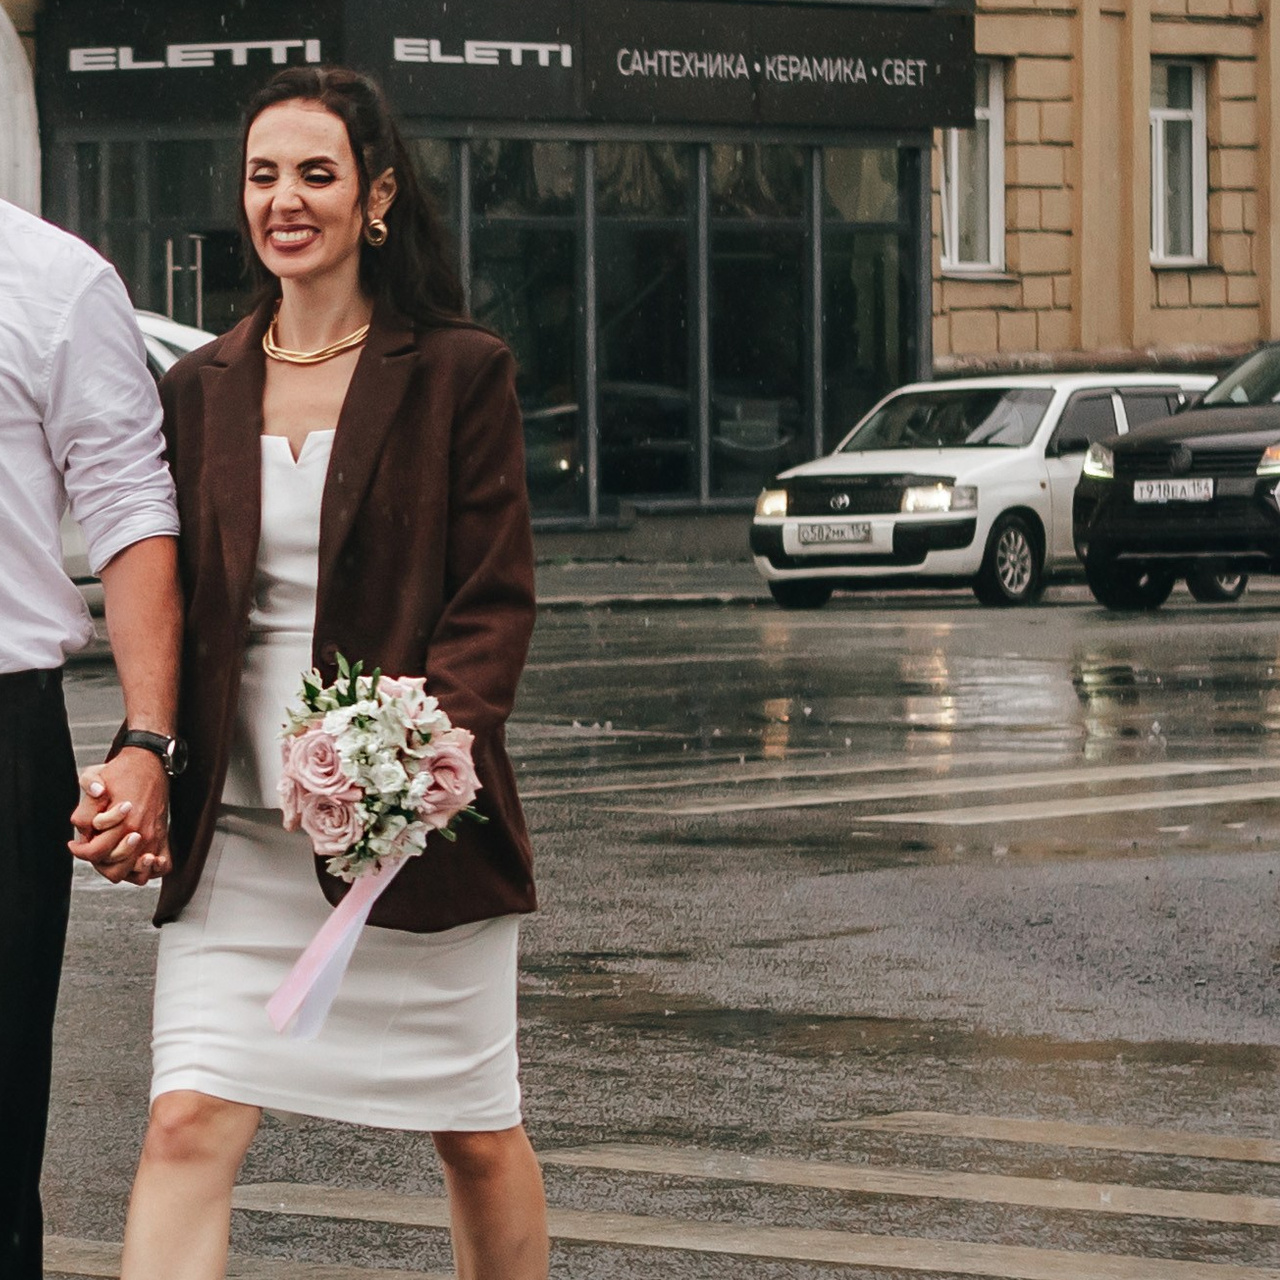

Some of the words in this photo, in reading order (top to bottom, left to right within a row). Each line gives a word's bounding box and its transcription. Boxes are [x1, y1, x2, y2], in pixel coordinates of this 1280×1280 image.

[69, 40, 322, 70] ELETTI
[393, 37, 573, 67] ELETTI
[616, 48, 750, 78] САНТЕХНИКА
[766, 54, 868, 83] КЕРАМИКА
[881, 58, 928, 85] СВЕТ
